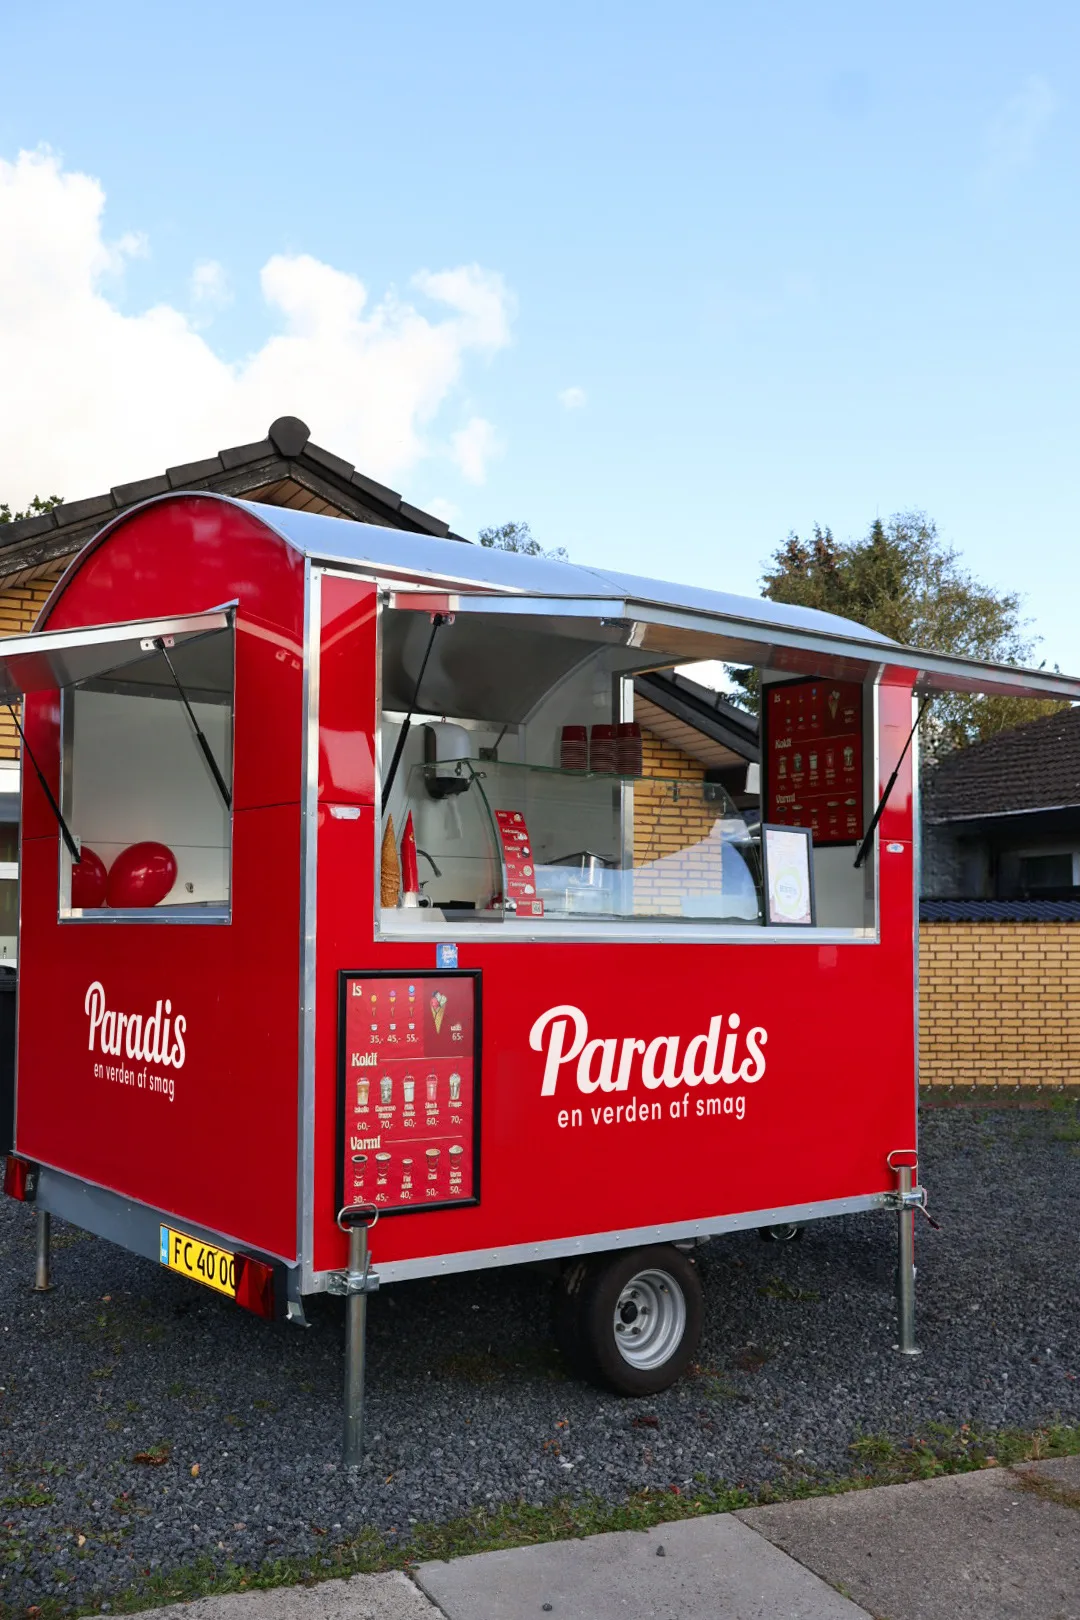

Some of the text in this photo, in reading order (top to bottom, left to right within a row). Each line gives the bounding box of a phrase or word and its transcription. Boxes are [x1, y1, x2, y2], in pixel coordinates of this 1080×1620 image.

[352, 982, 362, 996] Is
[85, 981, 187, 1069] Paradis
[351, 1052, 378, 1067] Koldt
[529, 1004, 768, 1097] Paradis
[94, 1062, 175, 1102] en verden af smag
[557, 1092, 746, 1128] en verden af smag
[350, 1135, 381, 1151] Varmt
[174, 1236, 193, 1271] FC
